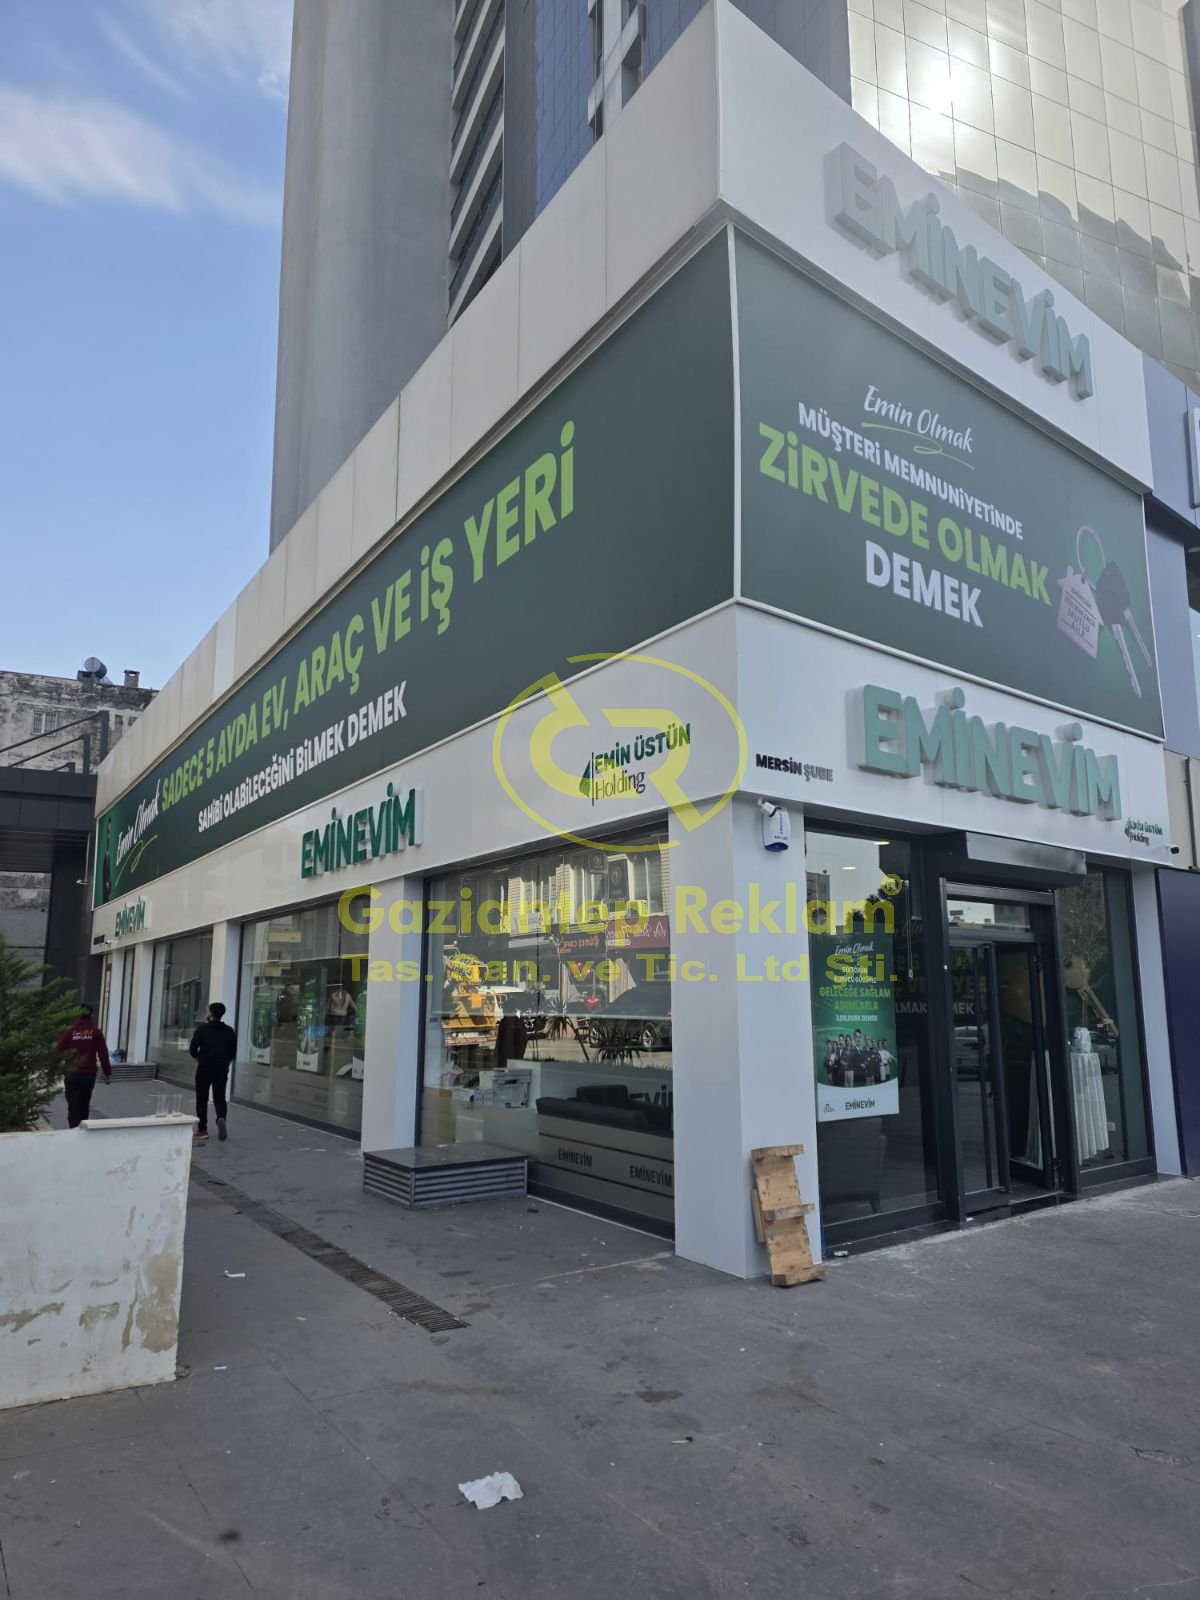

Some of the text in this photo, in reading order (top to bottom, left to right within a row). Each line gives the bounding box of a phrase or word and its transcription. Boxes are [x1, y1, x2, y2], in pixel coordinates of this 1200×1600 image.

[826, 142, 1093, 399] EMİNEVİM
[864, 385, 973, 453] Emin Olmak
[759, 422, 1052, 606] ZİRVEDE OLMAK
[799, 402, 1023, 540] MÜŞTERİ MEMNUNİYETİNDE
[162, 420, 575, 812] SADECE 5 AYDA EV, ARAÇ VE İŞ YERİ
[866, 540, 984, 628] DEMEK
[198, 680, 408, 832] SAHİBİ OLABİLECEĞİNİ BİLMEK DEMEK
[595, 723, 690, 774] EMİN ÜSTÜN
[596, 769, 646, 800] Holding
[756, 753, 833, 782] MERSİN ŞUBE
[853, 684, 1122, 821] EMİNEVİM
[116, 778, 161, 866] Emin Olmak
[301, 782, 420, 879] EMİNEVİM
